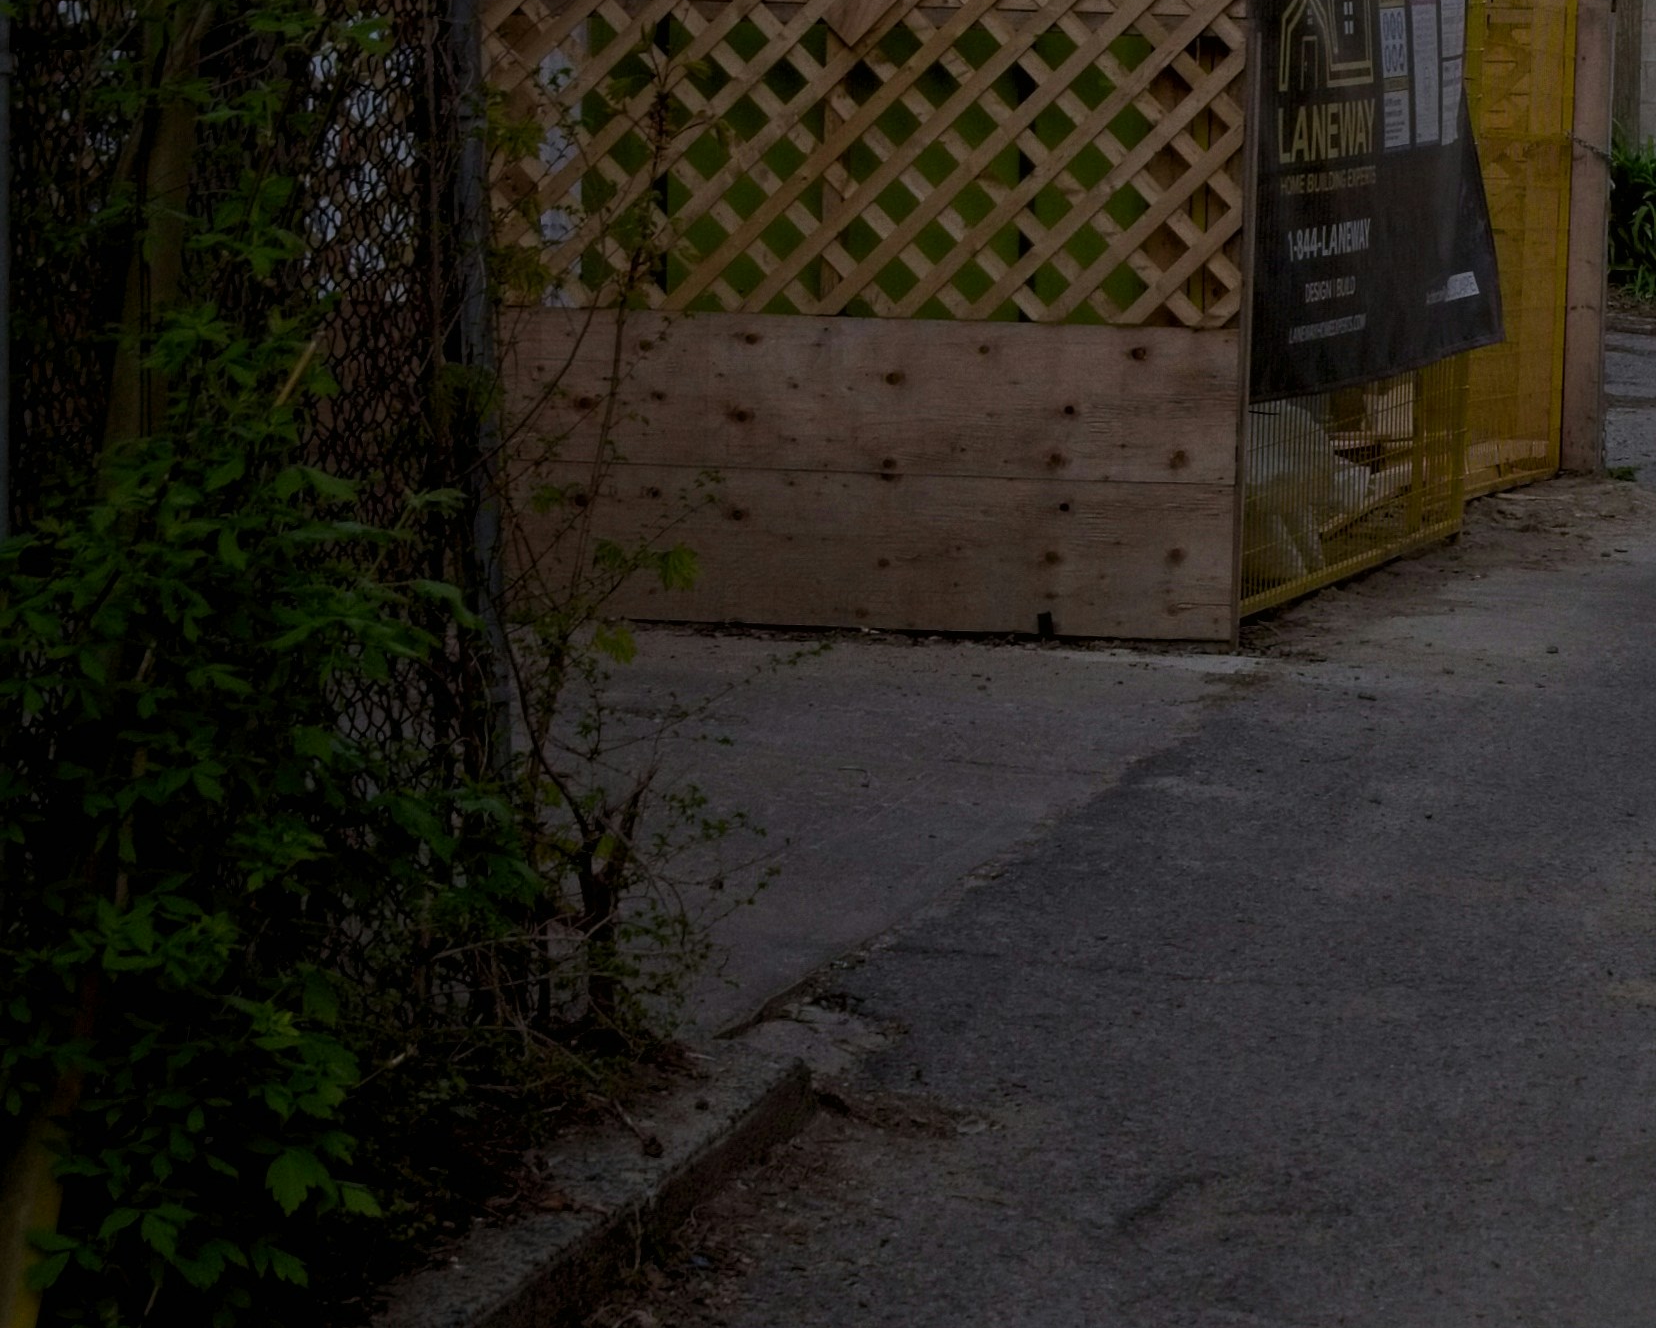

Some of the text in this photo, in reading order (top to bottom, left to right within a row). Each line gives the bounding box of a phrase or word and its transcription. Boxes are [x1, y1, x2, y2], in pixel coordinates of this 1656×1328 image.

[1278, 98, 1376, 164] LANEWAY
[1280, 174, 1305, 195] HOME
[1307, 169, 1346, 193] BUILDING
[1288, 218, 1371, 262] 1-844-LANEWAY
[1305, 275, 1356, 303] DESIGN BUILD
